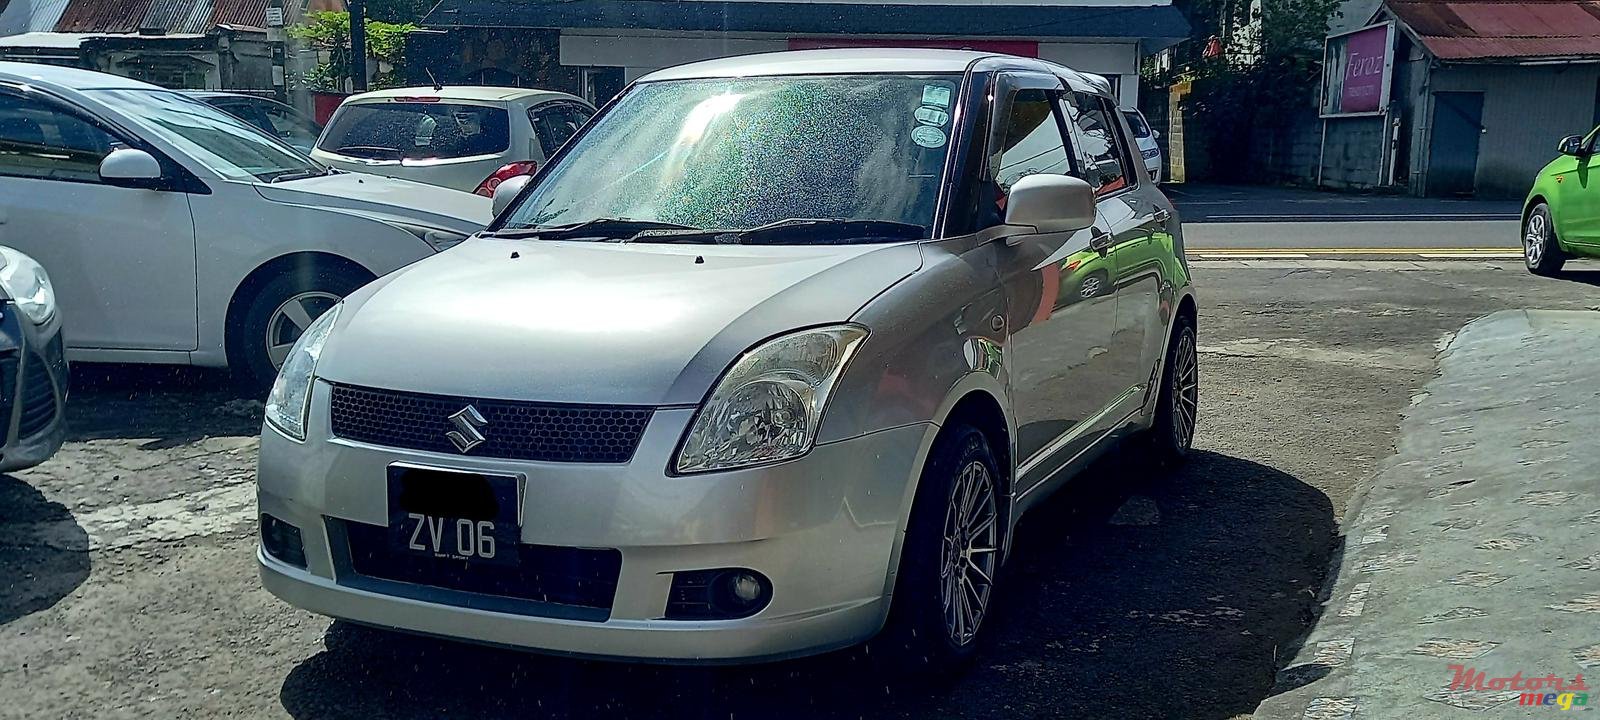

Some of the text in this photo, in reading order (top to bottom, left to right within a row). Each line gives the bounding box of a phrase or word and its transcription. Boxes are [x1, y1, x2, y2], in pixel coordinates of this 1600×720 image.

[1345, 52, 1383, 80] Feroz
[408, 512, 495, 558] ZV 06
